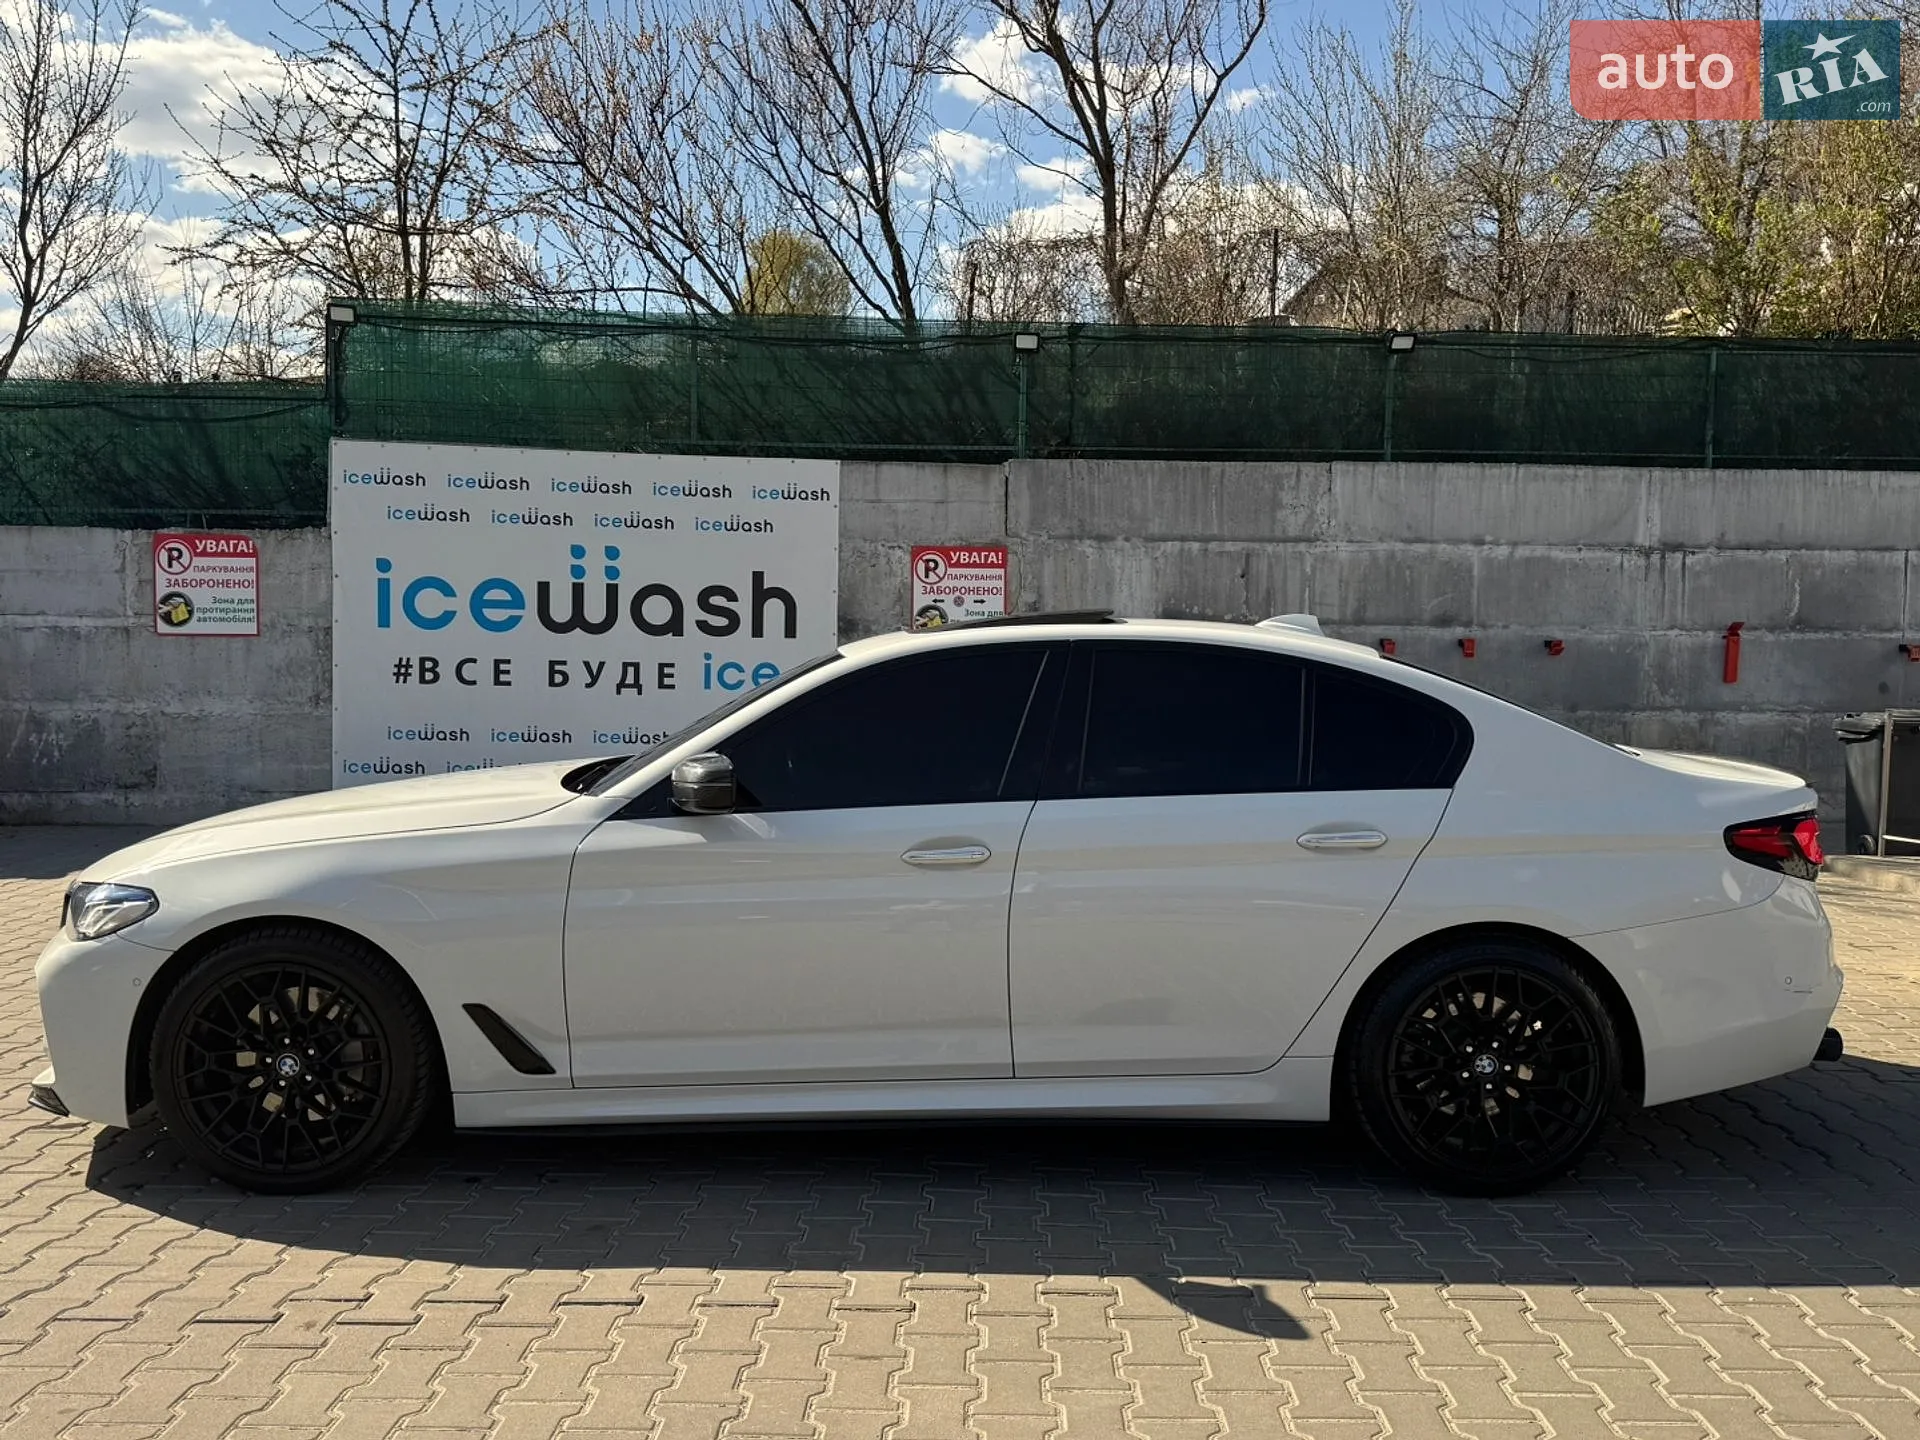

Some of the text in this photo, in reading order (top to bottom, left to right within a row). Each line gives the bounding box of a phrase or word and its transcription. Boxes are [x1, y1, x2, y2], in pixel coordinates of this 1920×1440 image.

[195, 539, 254, 553] УВАГА!
[949, 551, 1003, 564] УВАГА!
[193, 565, 255, 573] ПАРКУВАННЯ
[946, 573, 1003, 581] ПАРКУВАННЯ
[165, 578, 255, 590] ЗАБОРОНЕНО!
[375, 544, 798, 638] icewash
[921, 585, 1003, 596] ЗАБОРОНЕНО!
[211, 595, 255, 606] Зона для
[196, 605, 255, 616] протирання
[964, 608, 985, 617] Зона
[393, 652, 780, 696] #ВСЕ БУДЕ ice
